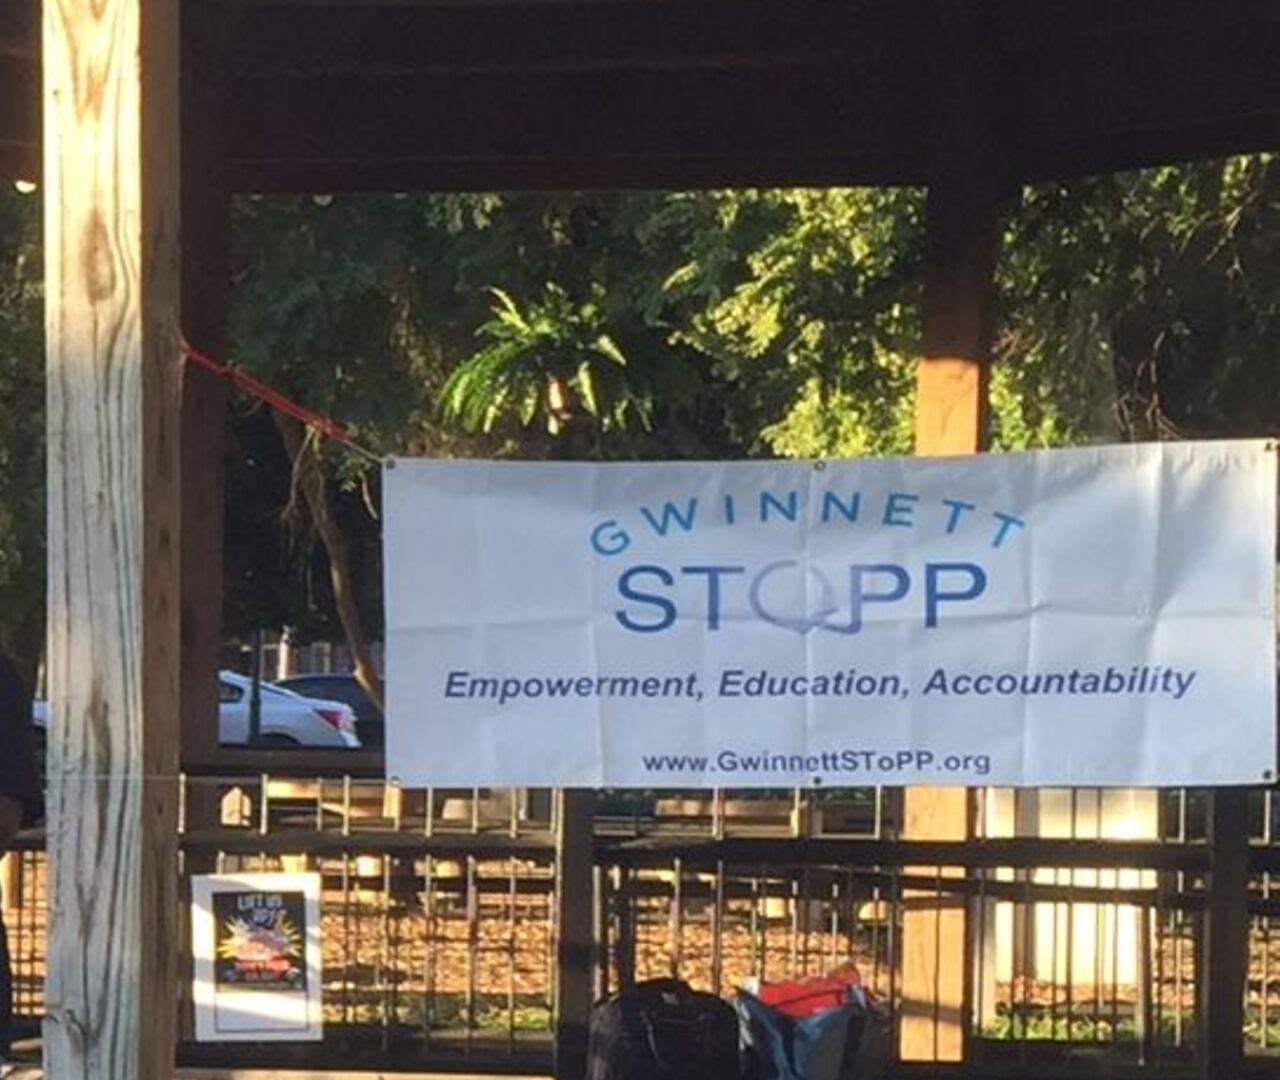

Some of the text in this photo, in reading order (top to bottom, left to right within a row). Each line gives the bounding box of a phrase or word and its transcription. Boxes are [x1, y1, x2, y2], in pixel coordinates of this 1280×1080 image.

[589, 490, 1026, 557] GWINNETT
[615, 558, 988, 636] STOPP
[444, 666, 1198, 706] Empowerment, Education, Accountability
[642, 749, 992, 776] www.GwinnettSToPP.org
